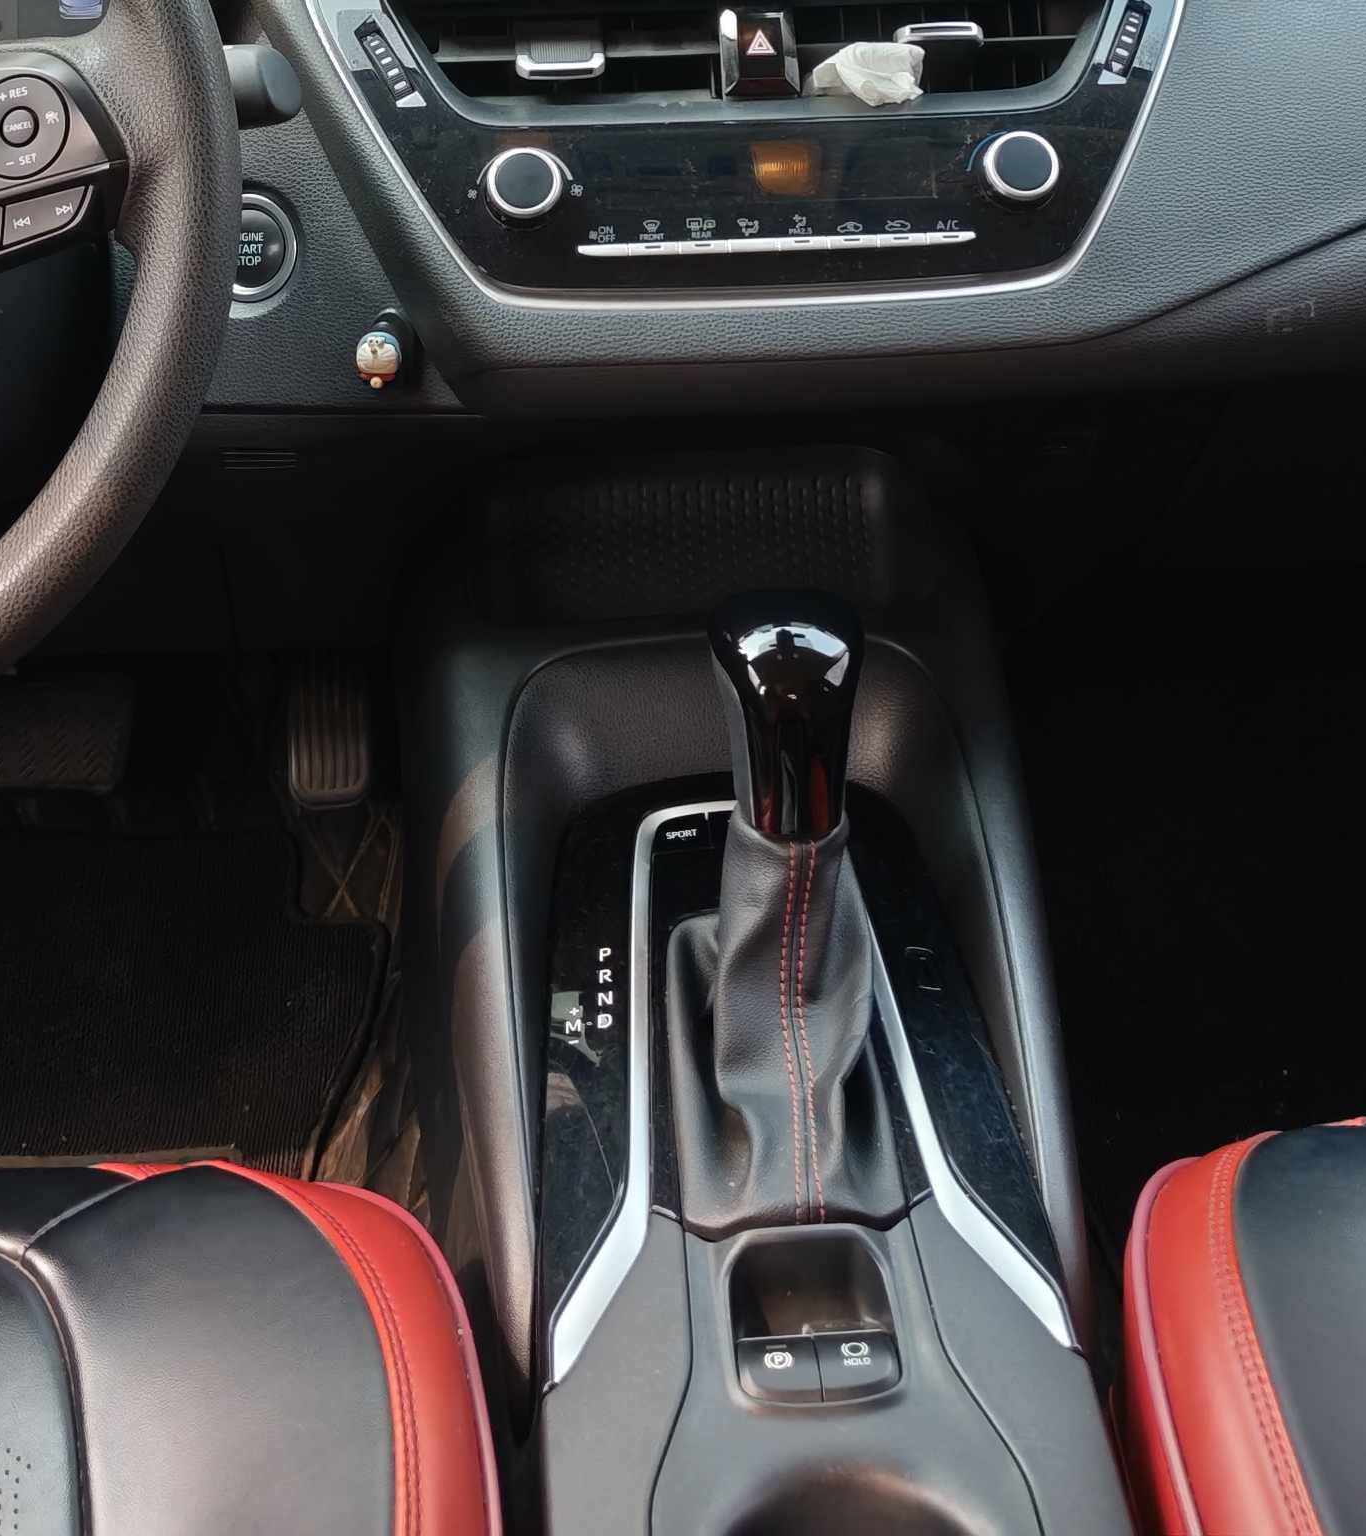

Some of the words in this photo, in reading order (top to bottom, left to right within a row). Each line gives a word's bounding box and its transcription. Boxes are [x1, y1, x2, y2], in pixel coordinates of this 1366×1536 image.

[9, 86, 28, 98] RES
[5, 120, 32, 133] CANCEL
[19, 154, 37, 166] SET
[598, 225, 614, 235] ON
[936, 220, 960, 230] A/C
[239, 231, 265, 242] GINE
[691, 231, 712, 239] REAR
[788, 227, 813, 235] PM2.5
[597, 234, 616, 244] OFF
[639, 233, 666, 241] FRONT
[238, 243, 264, 254] TART
[665, 828, 698, 840] SPORT
[598, 947, 612, 963] P
[598, 969, 613, 984] R
[597, 991, 613, 1006] N
[564, 1018, 582, 1034] M
[596, 1012, 613, 1030] D
[843, 1356, 872, 1367] HOLD
